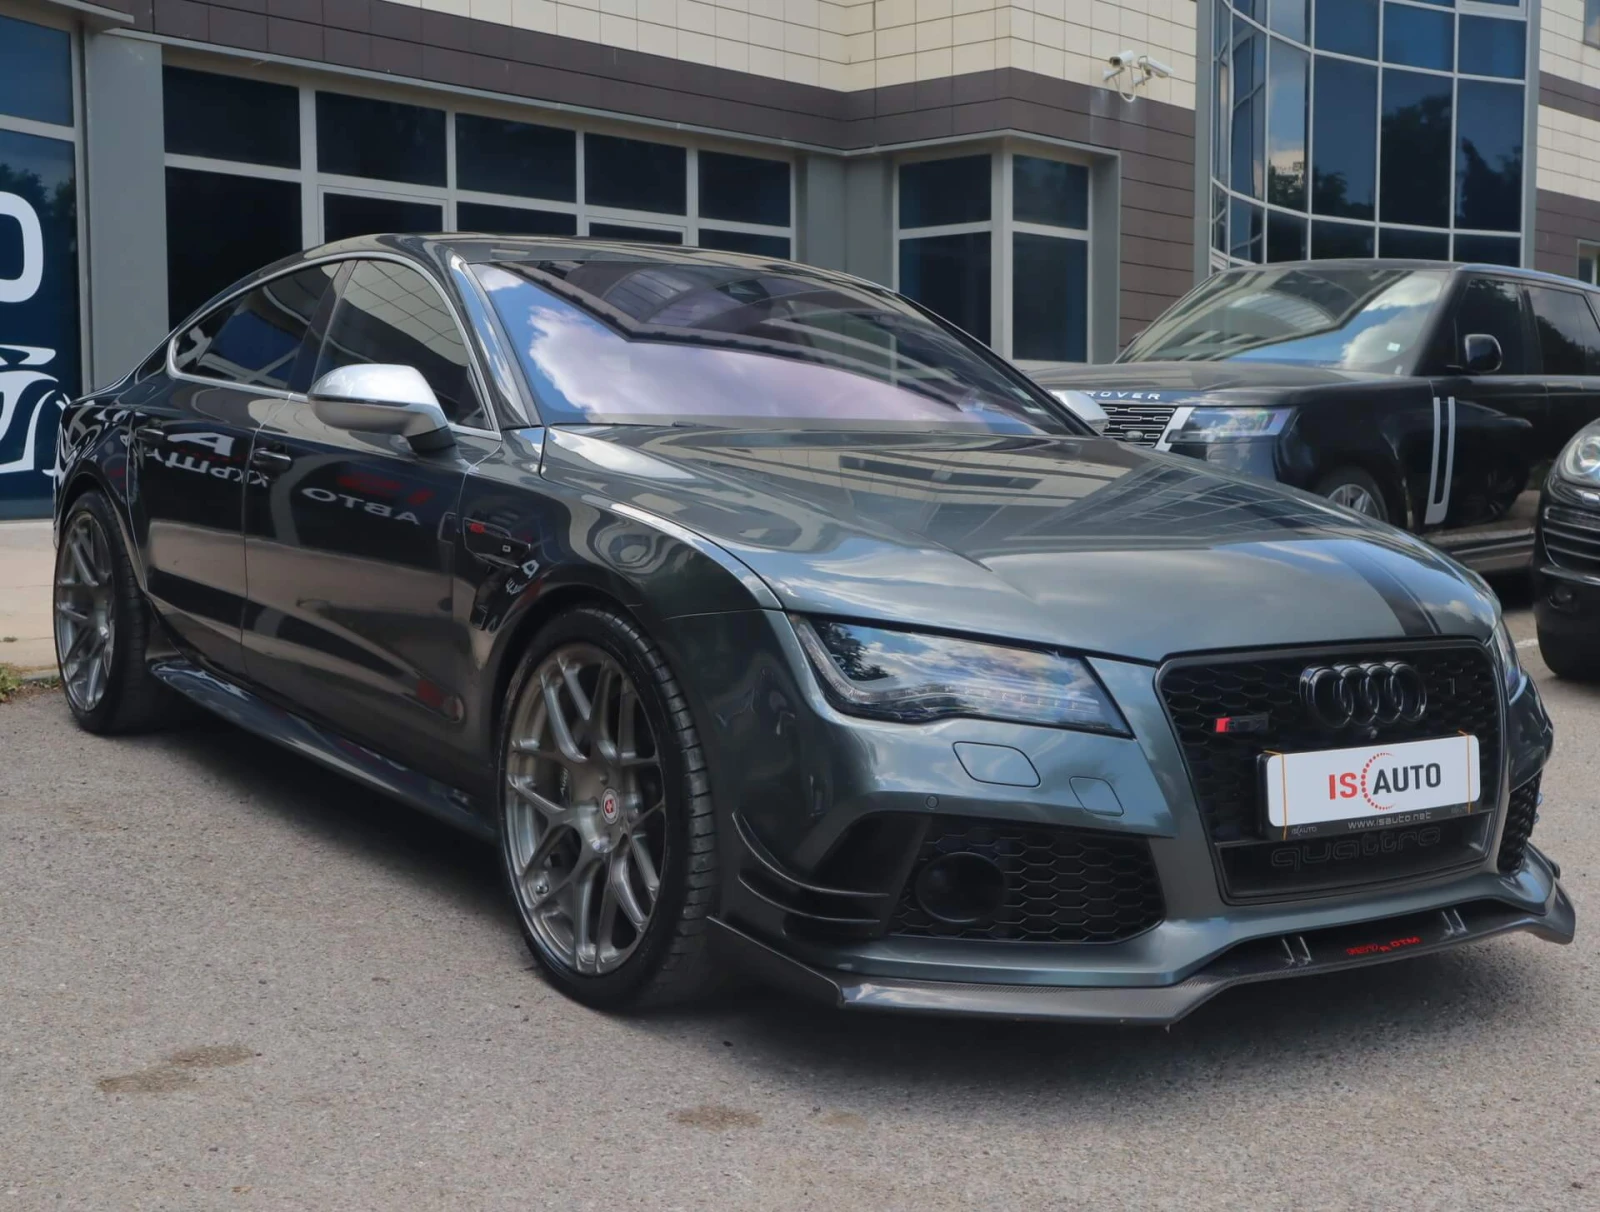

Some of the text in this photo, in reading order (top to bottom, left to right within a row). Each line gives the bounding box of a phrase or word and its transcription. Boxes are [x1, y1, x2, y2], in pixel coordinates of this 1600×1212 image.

[1328, 762, 1442, 800] IS AUTO
[1347, 811, 1432, 830] www.isauto.net
[1271, 826, 1441, 872] quattro
